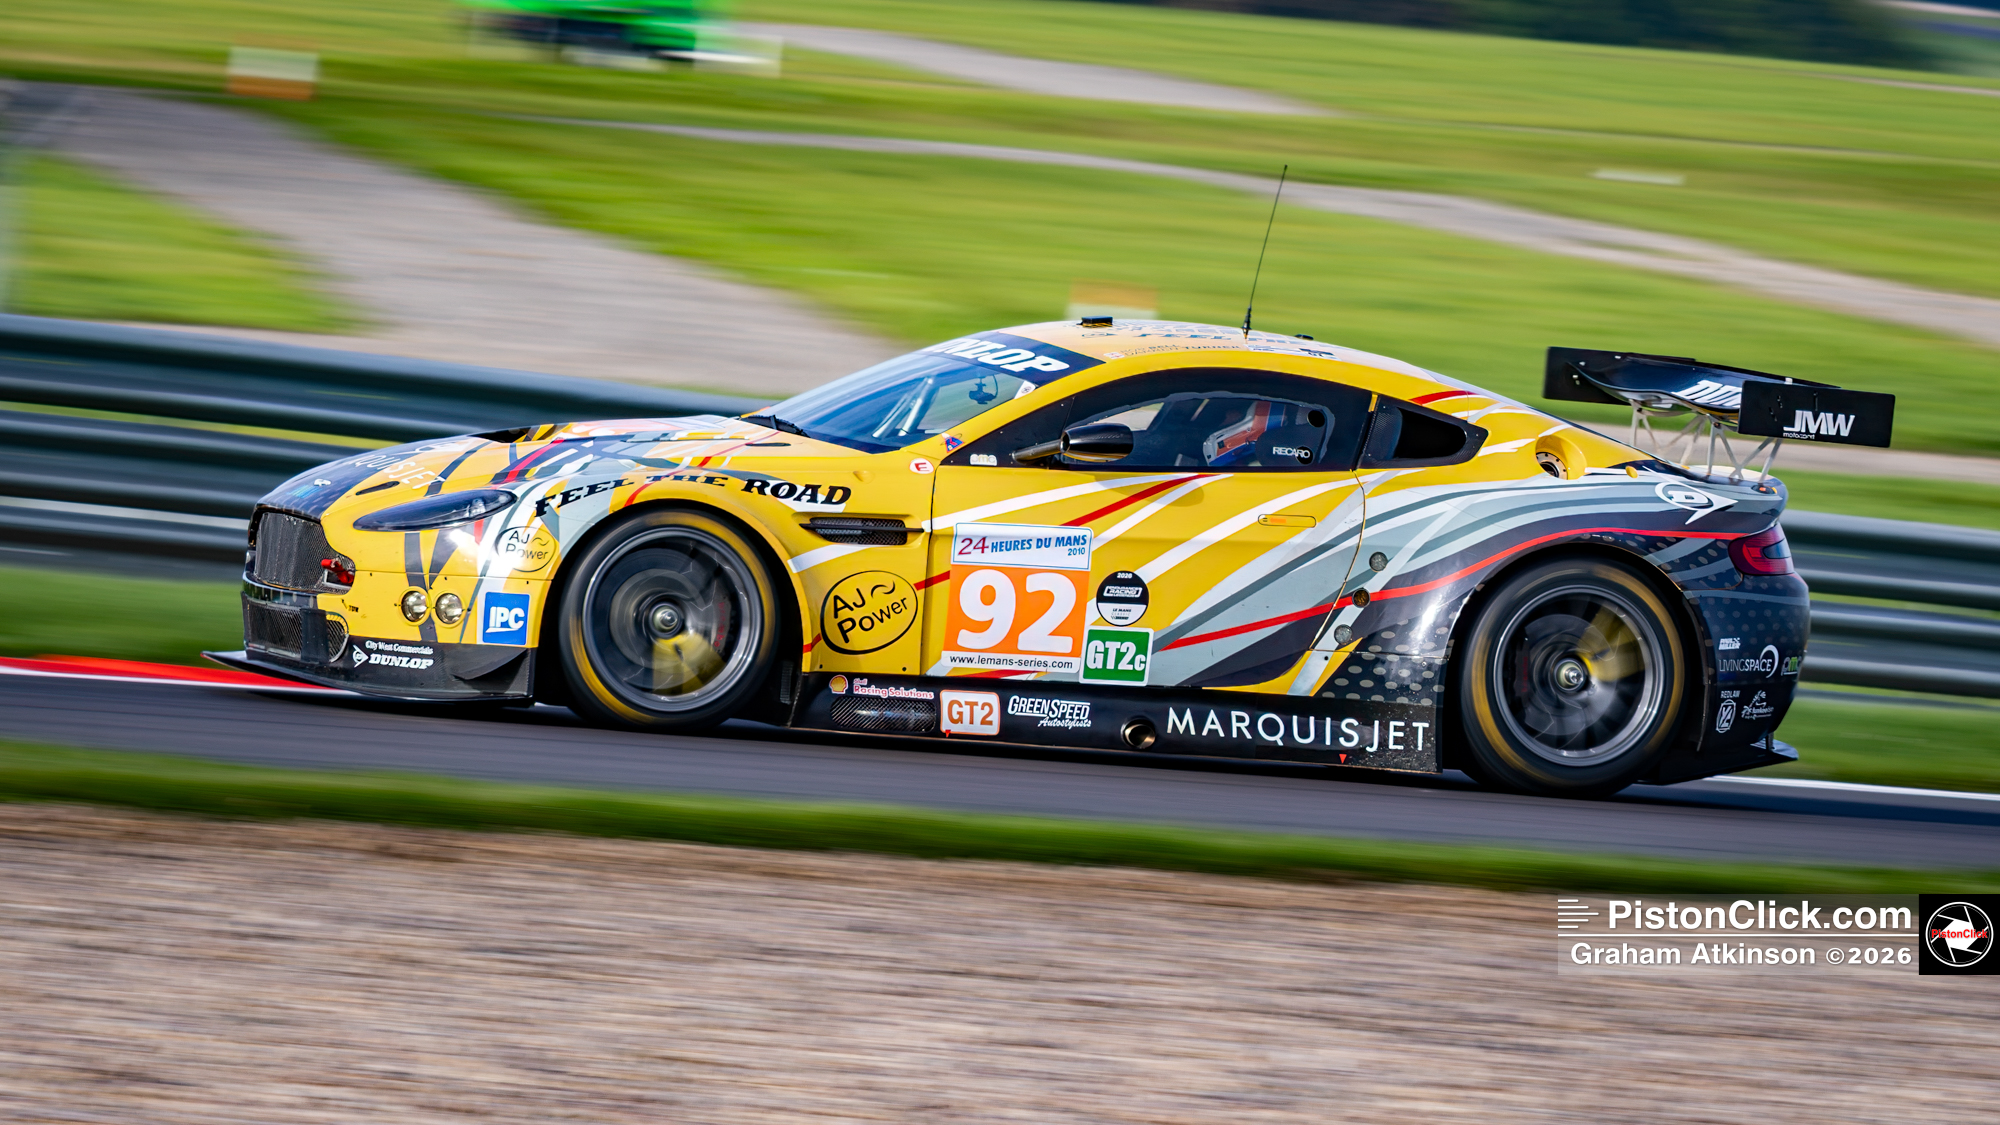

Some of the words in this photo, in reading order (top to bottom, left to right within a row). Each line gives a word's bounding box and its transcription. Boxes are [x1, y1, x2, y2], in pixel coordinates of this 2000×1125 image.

[931, 338, 1070, 373] NLOP
[1783, 409, 1856, 437] JMW
[1272, 446, 1311, 459] RECARO
[533, 478, 635, 518] FEEL
[646, 474, 730, 487] THE
[741, 478, 853, 506] ROAD
[508, 529, 530, 545] AJ
[957, 536, 989, 556] 24
[991, 538, 1033, 553] HEURES
[1036, 537, 1051, 549] DU
[1055, 534, 1088, 548] MANS
[505, 541, 549, 561] Power
[1067, 547, 1086, 557] 2010
[832, 587, 867, 619] AJ
[957, 569, 1077, 653] 92
[488, 606, 526, 631] IPC
[837, 597, 908, 644] Power
[368, 653, 434, 669] DUNLOP
[949, 654, 1074, 670] www.lemans-series.com
[1086, 639, 1147, 672] GT2c
[853, 684, 887, 698] Racing
[888, 687, 935, 700] Solutions
[947, 699, 994, 726] GT2
[1037, 715, 1092, 730] Autostylists
[1166, 706, 1431, 753] MARQUISJET
